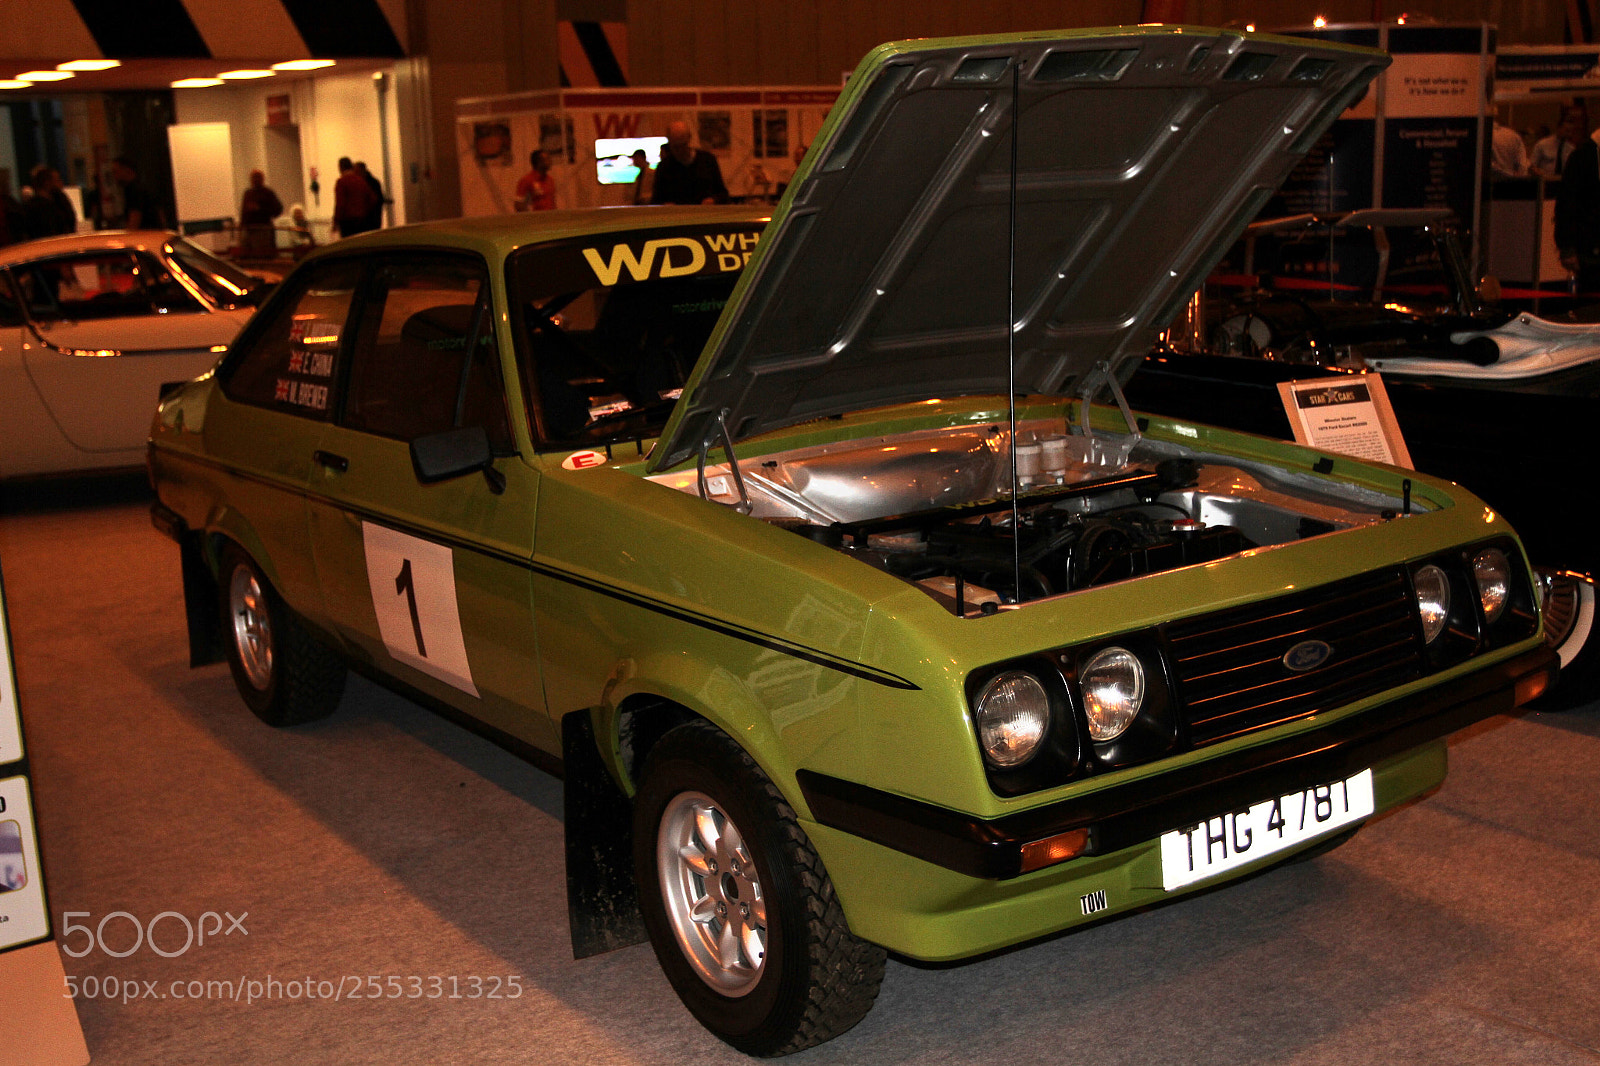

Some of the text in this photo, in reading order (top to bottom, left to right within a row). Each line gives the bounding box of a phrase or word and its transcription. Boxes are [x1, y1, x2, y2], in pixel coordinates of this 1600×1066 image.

[582, 237, 706, 286] WD
[571, 453, 599, 468] E
[395, 558, 428, 658] 1
[1080, 891, 1107, 914] TOW
